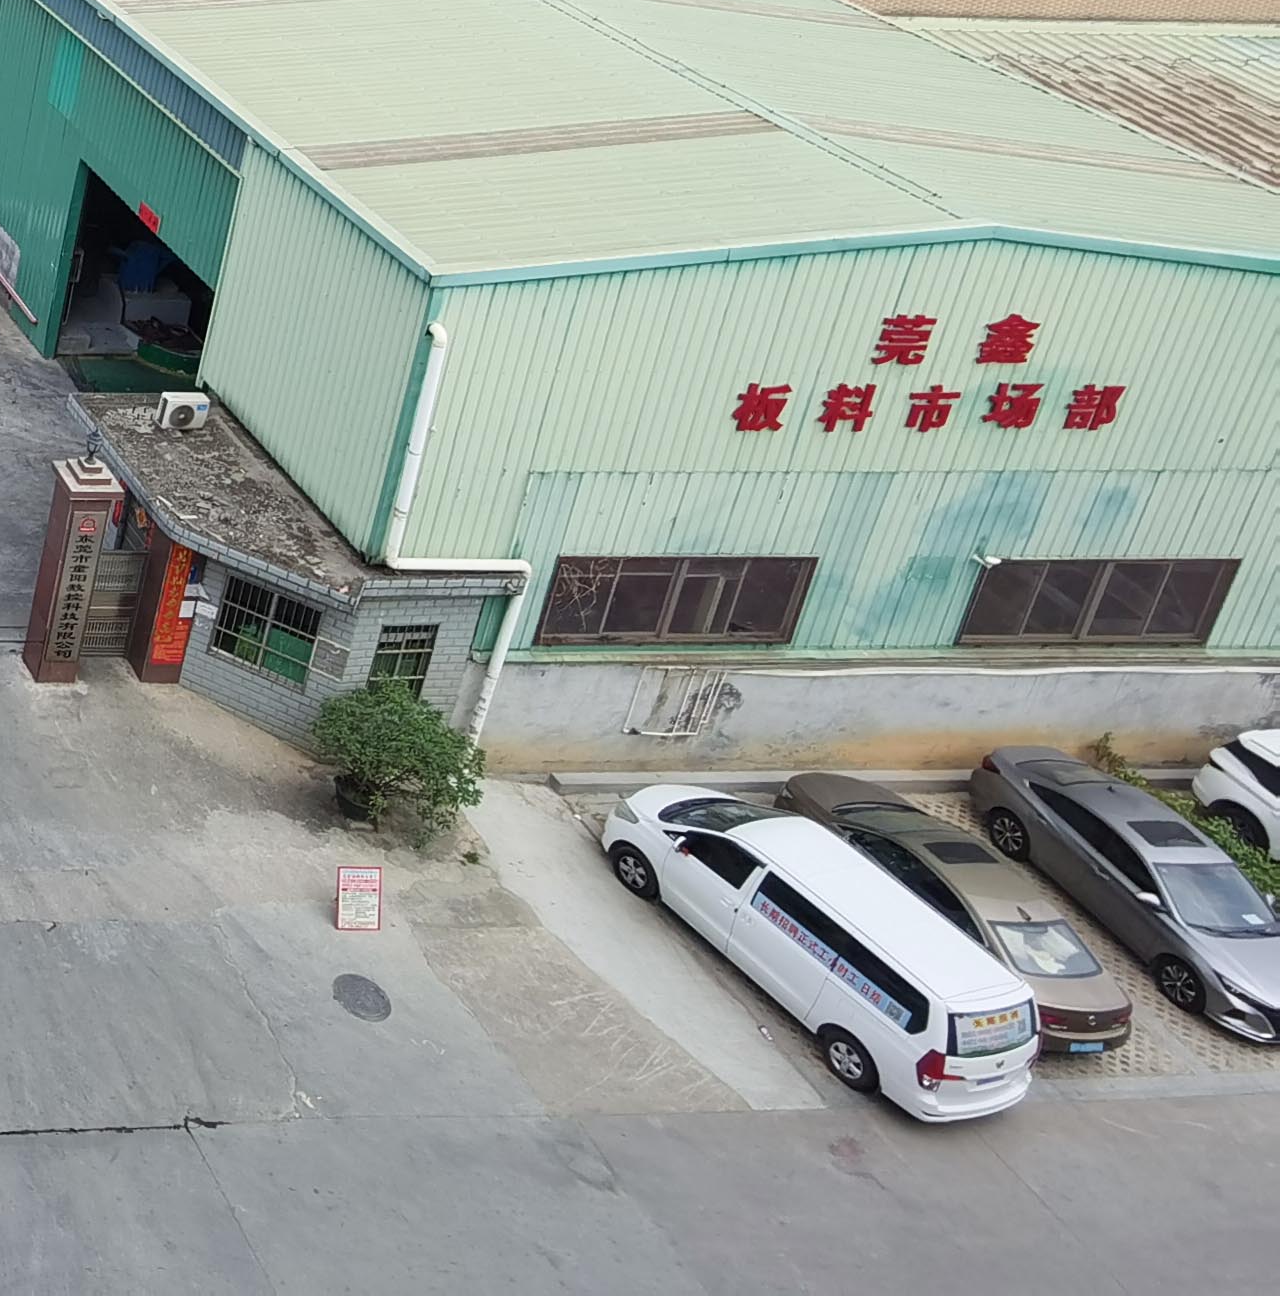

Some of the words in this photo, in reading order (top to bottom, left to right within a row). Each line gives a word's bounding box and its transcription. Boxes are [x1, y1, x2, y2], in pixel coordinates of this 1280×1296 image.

[872, 314, 1041, 366] 莞鑫
[732, 383, 1126, 432] 板料市场部
